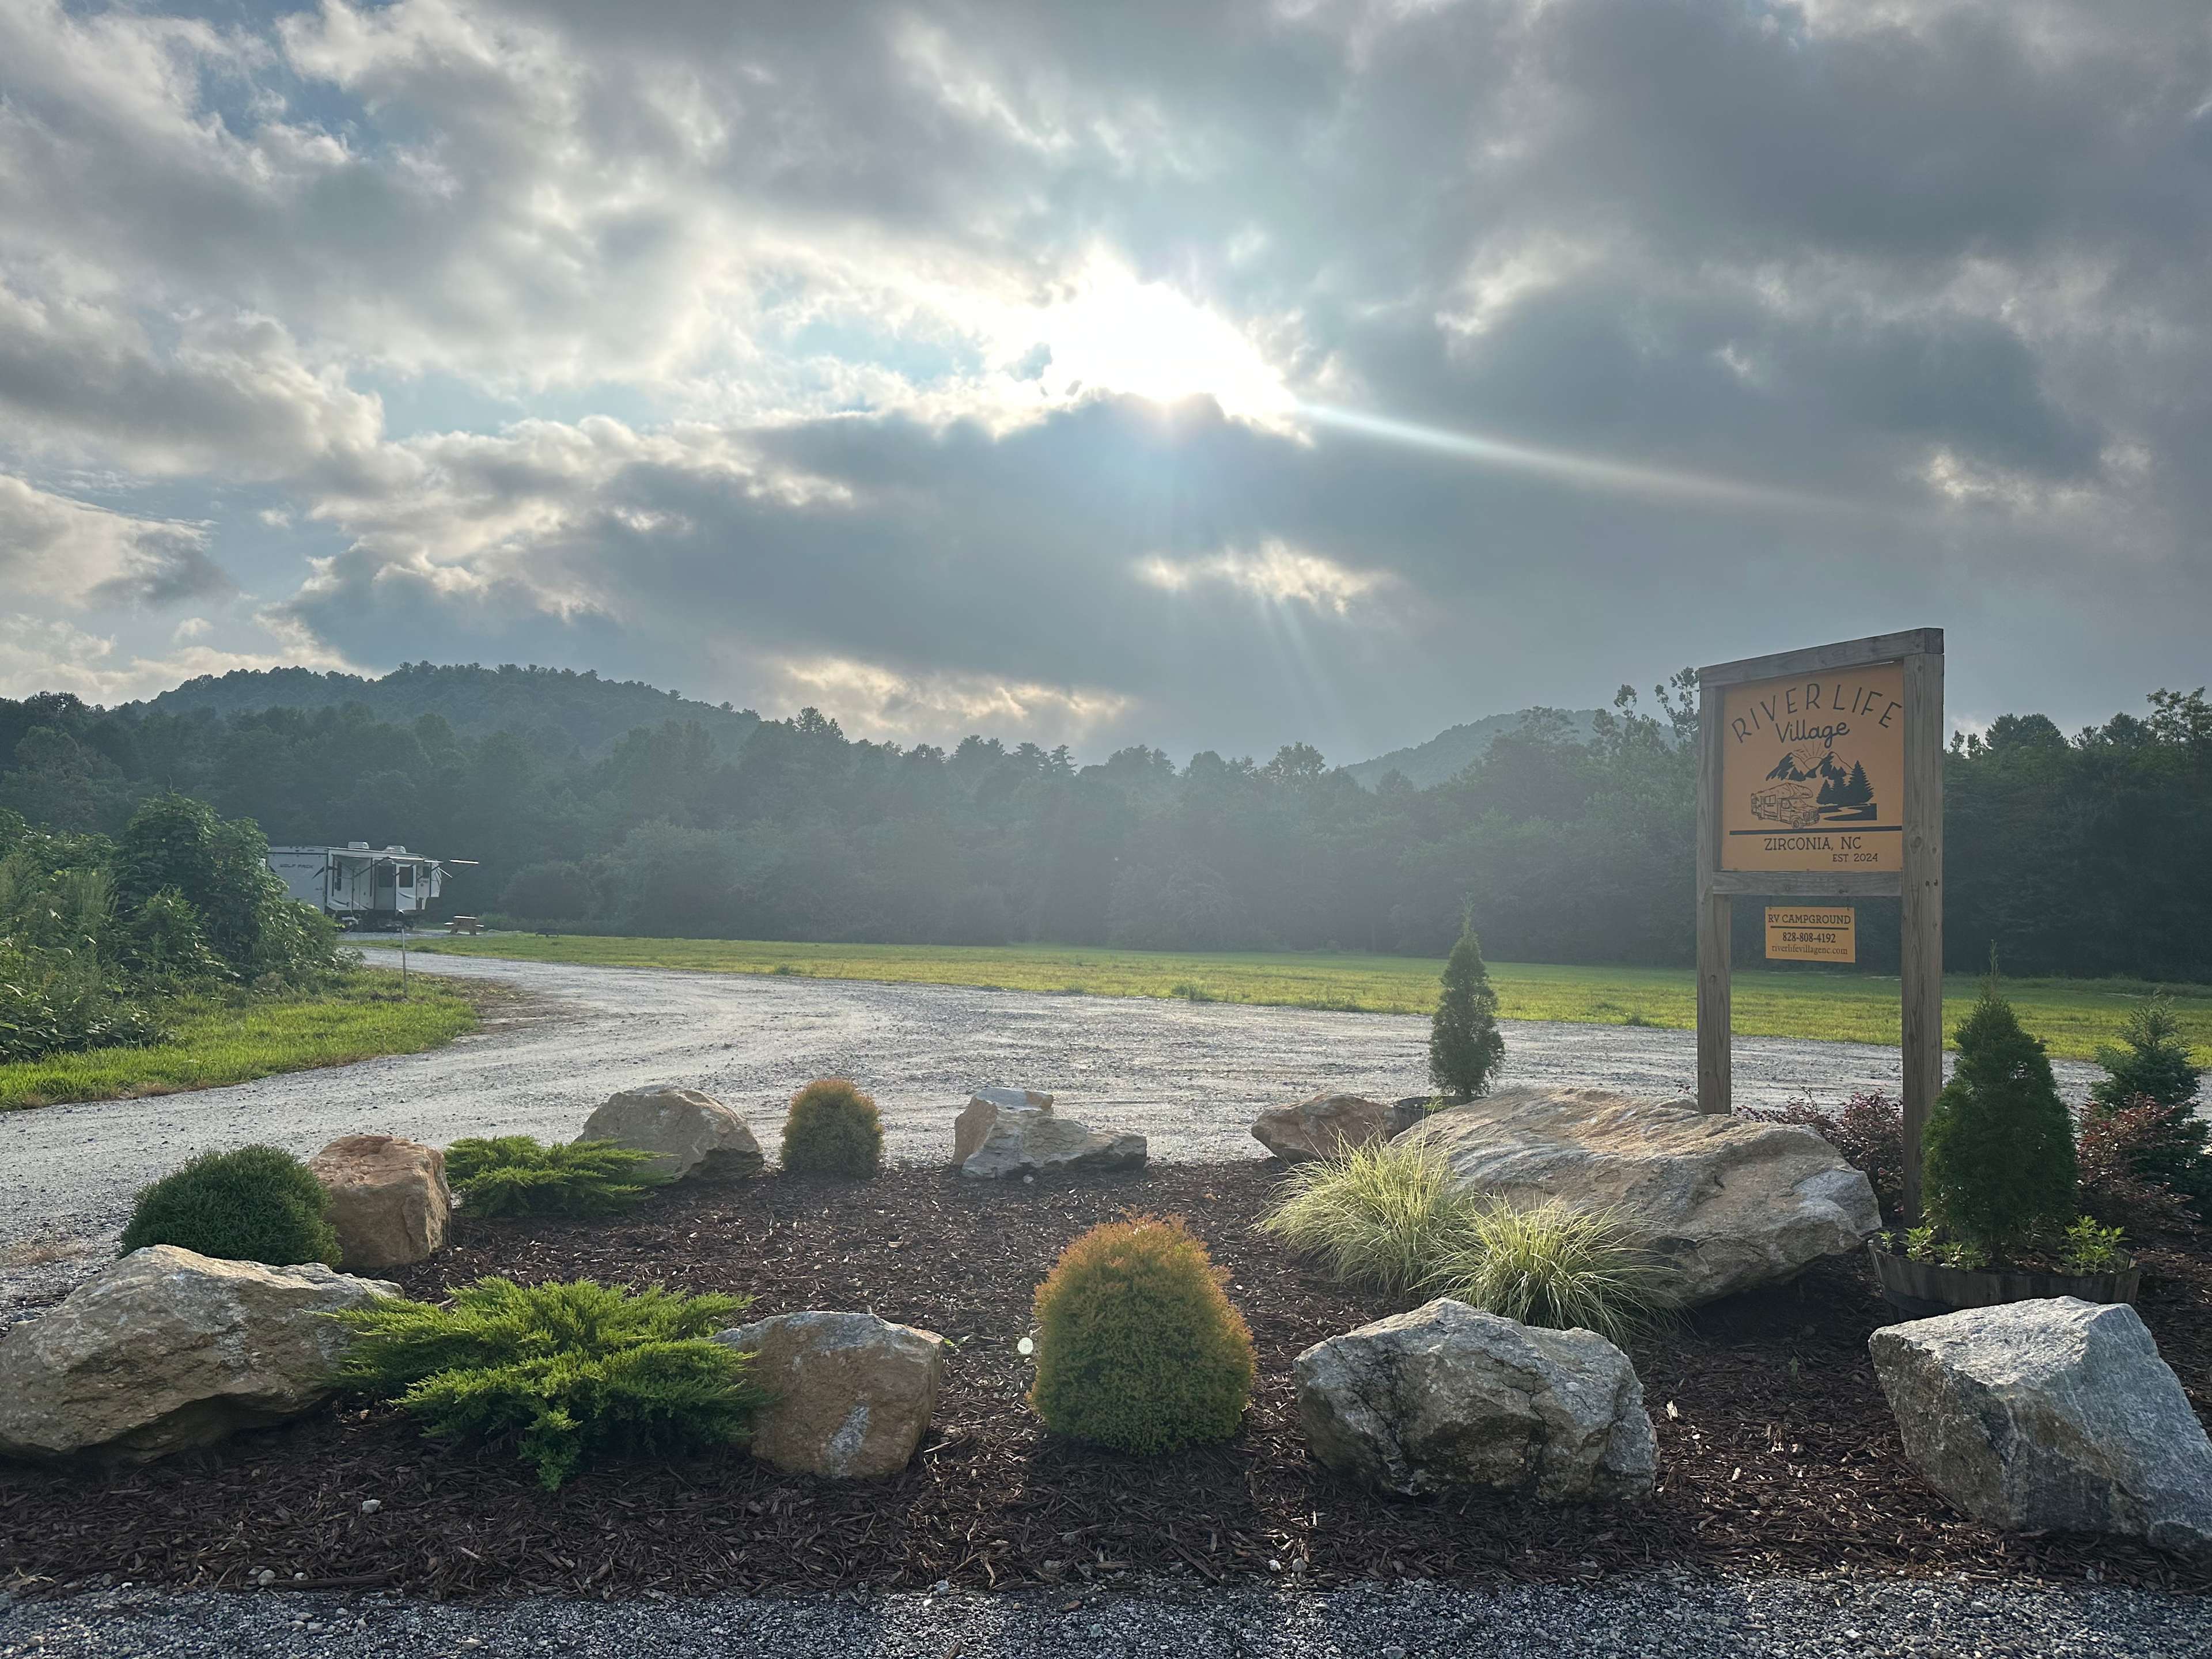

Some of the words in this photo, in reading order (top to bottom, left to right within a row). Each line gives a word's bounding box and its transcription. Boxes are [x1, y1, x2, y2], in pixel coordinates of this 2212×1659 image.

[1775, 720, 1850, 748] Village
[1764, 838, 1834, 851] ZIRCONIA,
[1841, 837, 1861, 850] NC
[1832, 854, 1849, 862] EST
[1854, 853, 1878, 862] 2024
[1768, 914, 1780, 923] RV
[1782, 914, 1851, 924] CAMPGROUND
[1782, 932, 1836, 943] 828-808-4192
[1772, 944, 1848, 955] riverlifevillagenc.com
